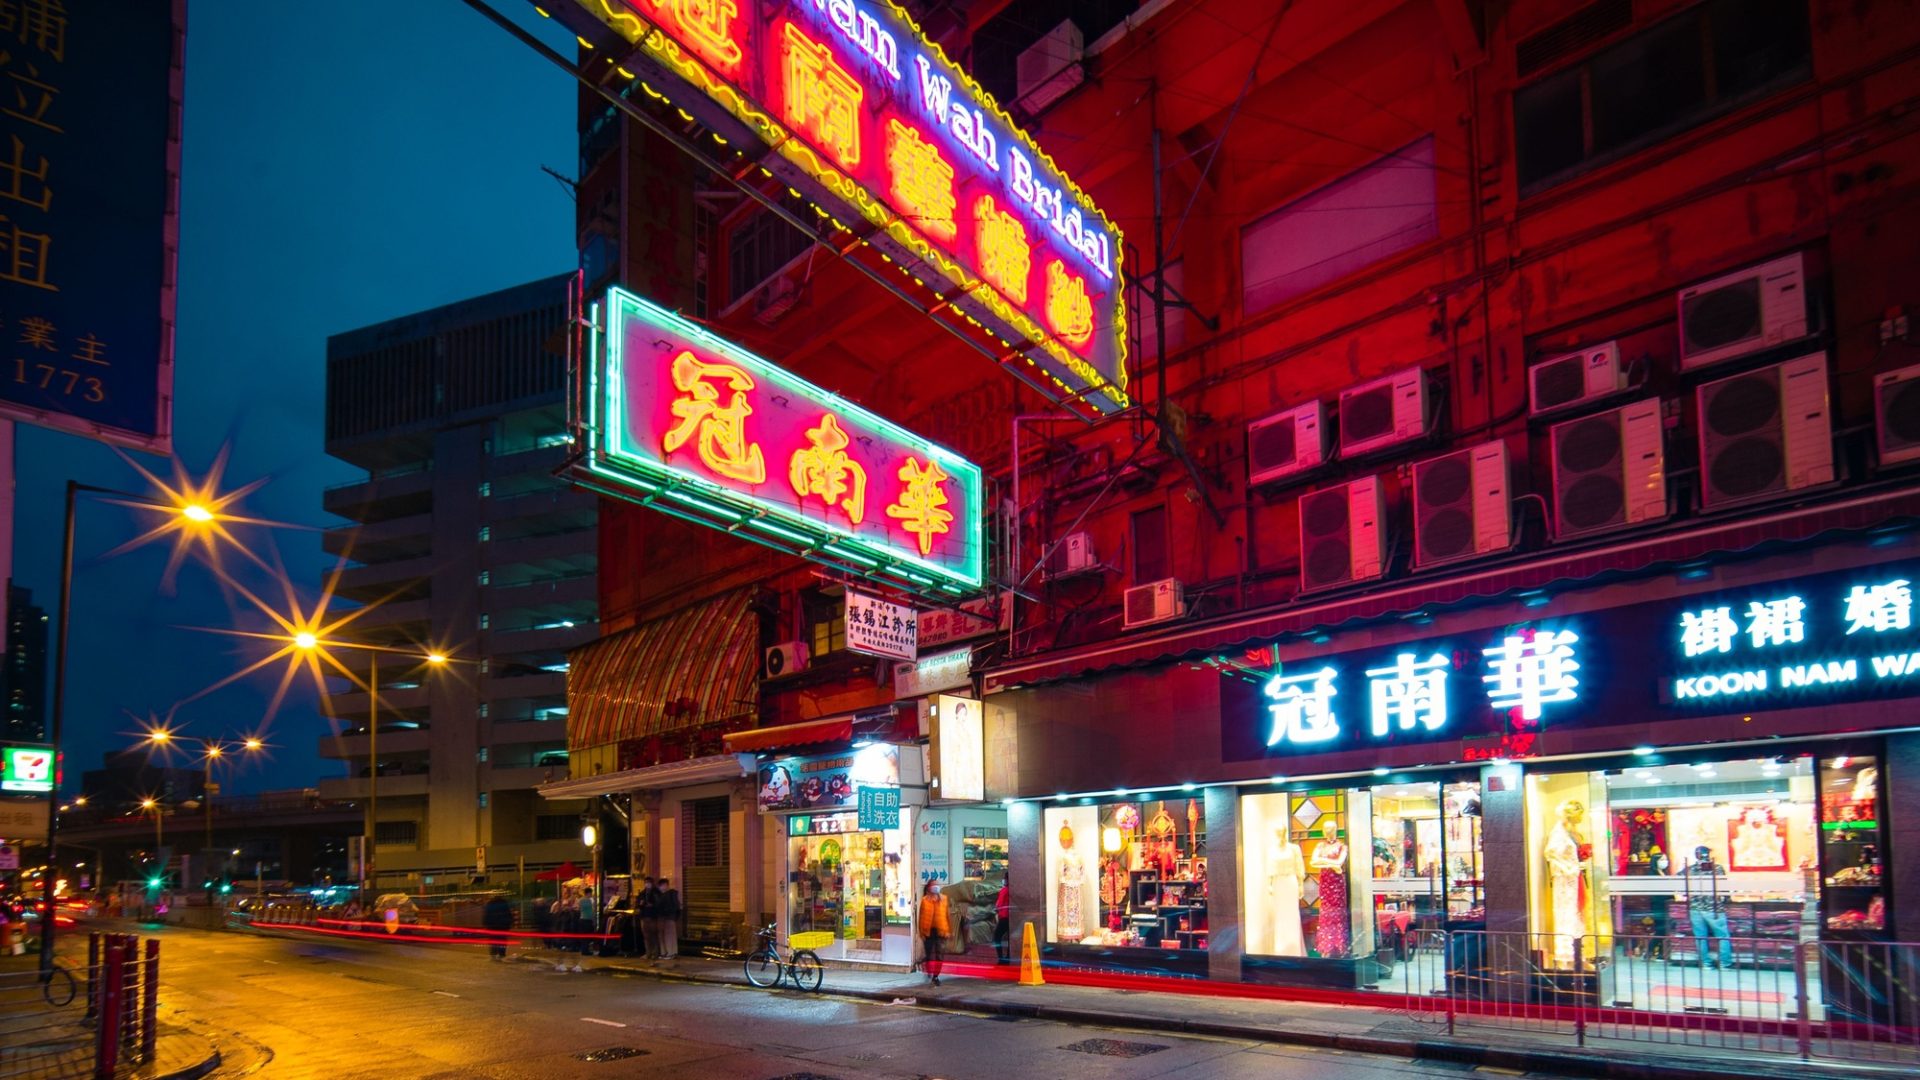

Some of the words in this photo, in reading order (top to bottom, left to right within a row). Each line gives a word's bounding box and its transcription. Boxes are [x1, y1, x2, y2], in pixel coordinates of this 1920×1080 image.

[810, 0, 900, 80] am
[914, 54, 999, 171] Wah
[1010, 147, 1113, 279] Bridal
[12, 357, 105, 403] 1773
[663, 351, 954, 555] 冠南華
[1680, 596, 1806, 657] 褂裙
[1844, 579, 1913, 635] 婚
[1263, 628, 1581, 747] 冠南華
[1675, 669, 1768, 698] KOON
[1780, 659, 1857, 688] NAM
[865, 791, 873, 823] Laundry
[874, 792, 898, 808] 自助
[874, 809, 898, 826] 洗衣
[929, 820, 947, 830] 4PX
